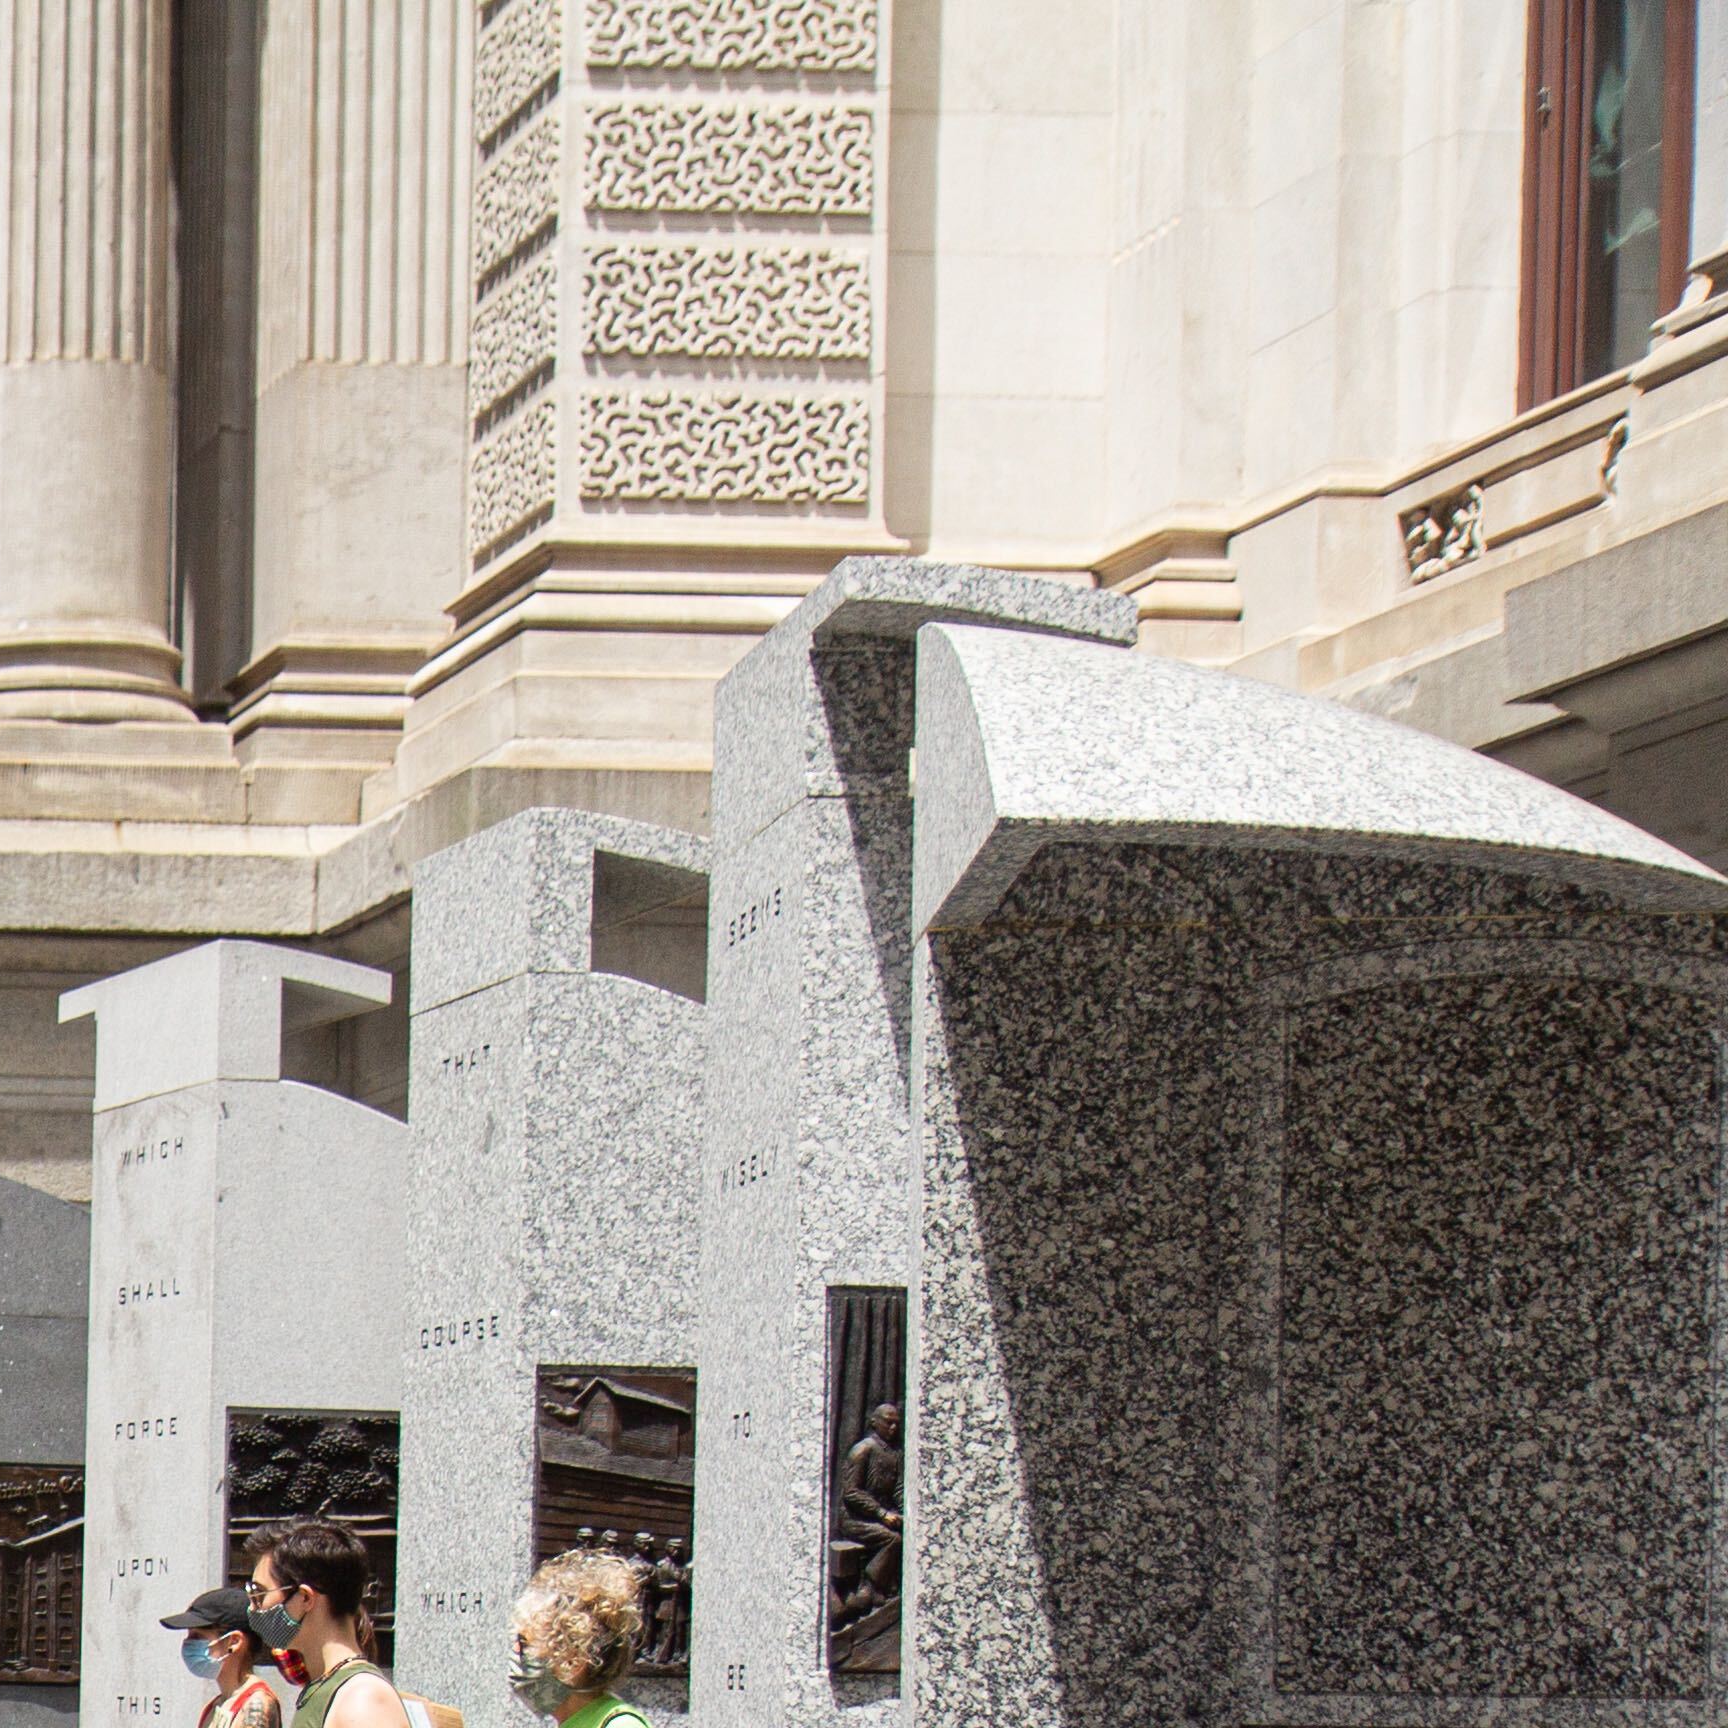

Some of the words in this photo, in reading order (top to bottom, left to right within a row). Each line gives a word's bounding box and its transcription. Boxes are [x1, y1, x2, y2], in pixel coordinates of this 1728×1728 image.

[121, 1138, 184, 1166] WHICH
[119, 1279, 180, 1306] SHALL
[117, 1557, 170, 1578] UPON
[116, 1697, 162, 1716] THIS
